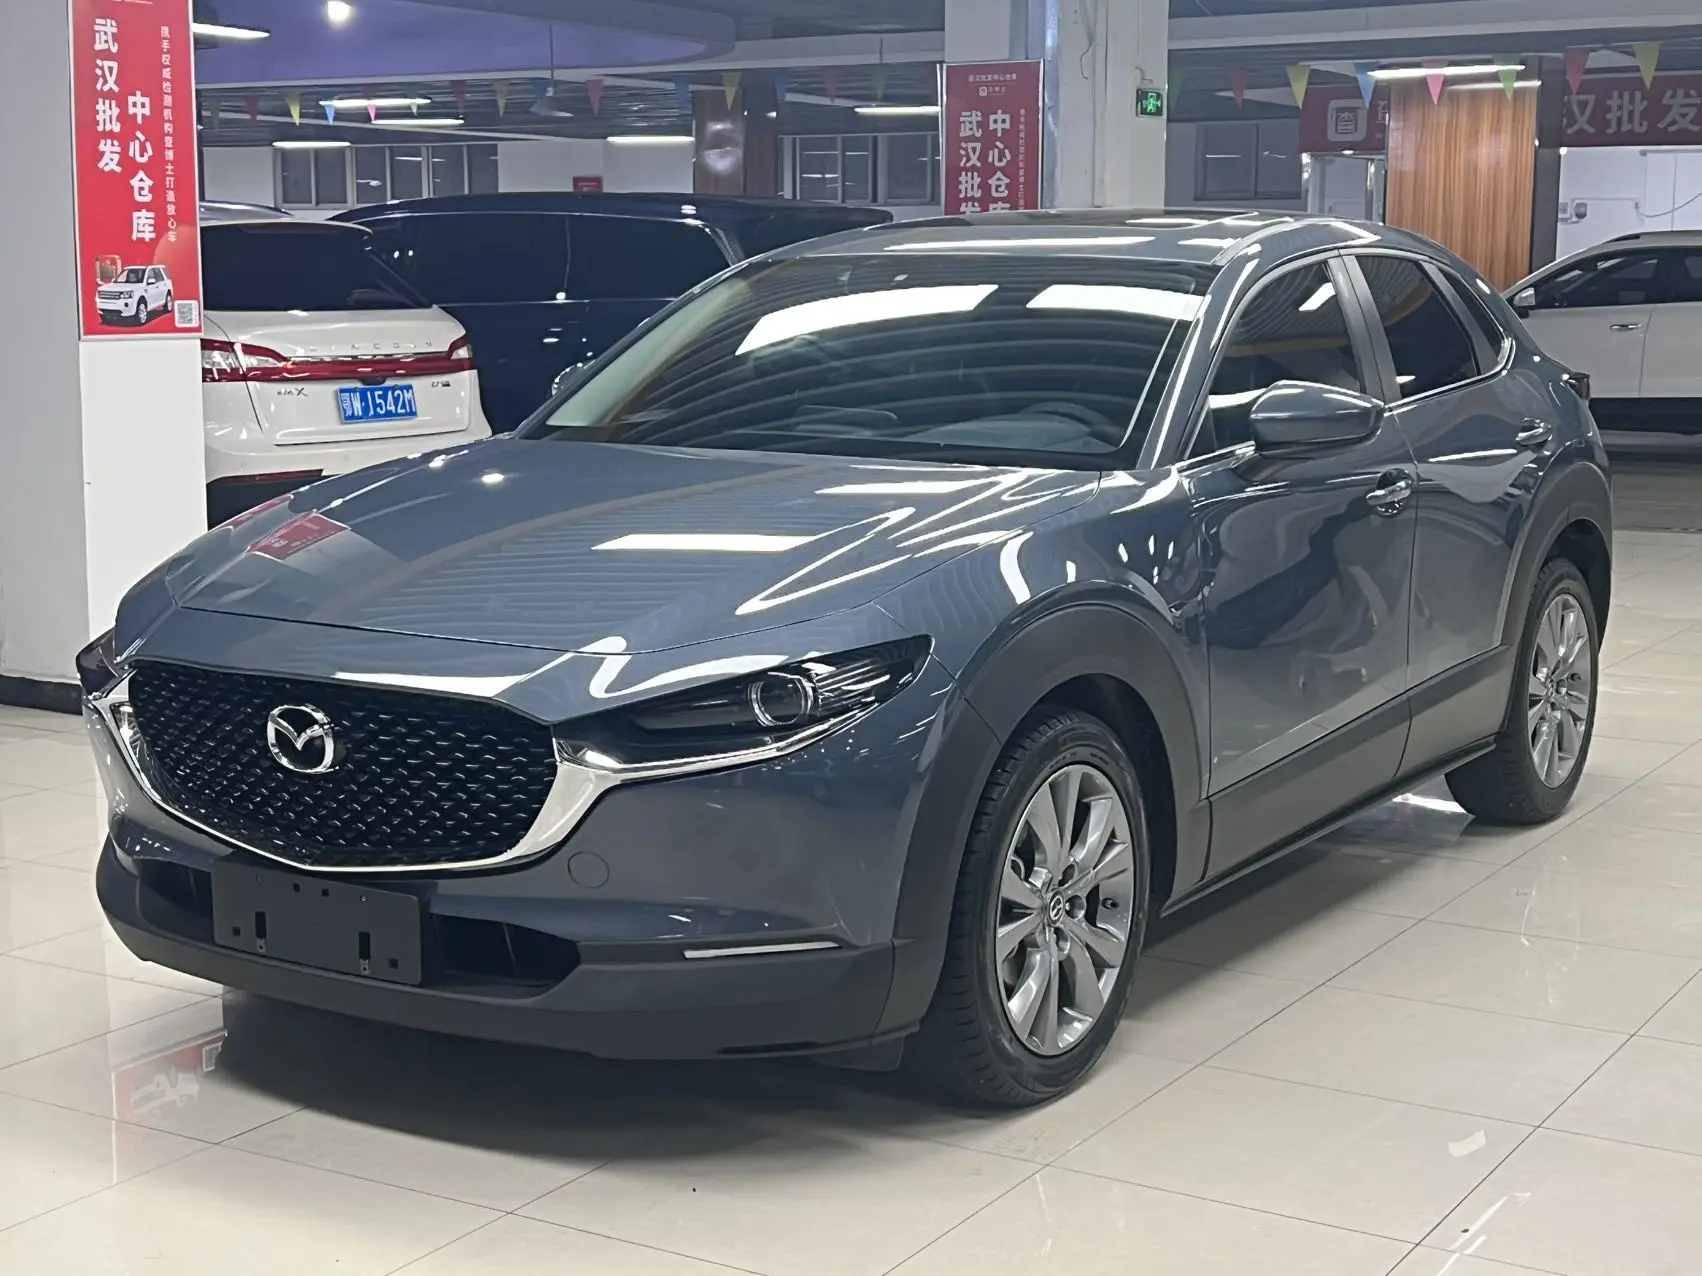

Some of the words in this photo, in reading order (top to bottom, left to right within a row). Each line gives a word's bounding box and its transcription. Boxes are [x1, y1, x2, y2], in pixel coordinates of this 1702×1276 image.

[94, 17, 123, 174] 武汉批发
[127, 90, 157, 242] 中心仓库
